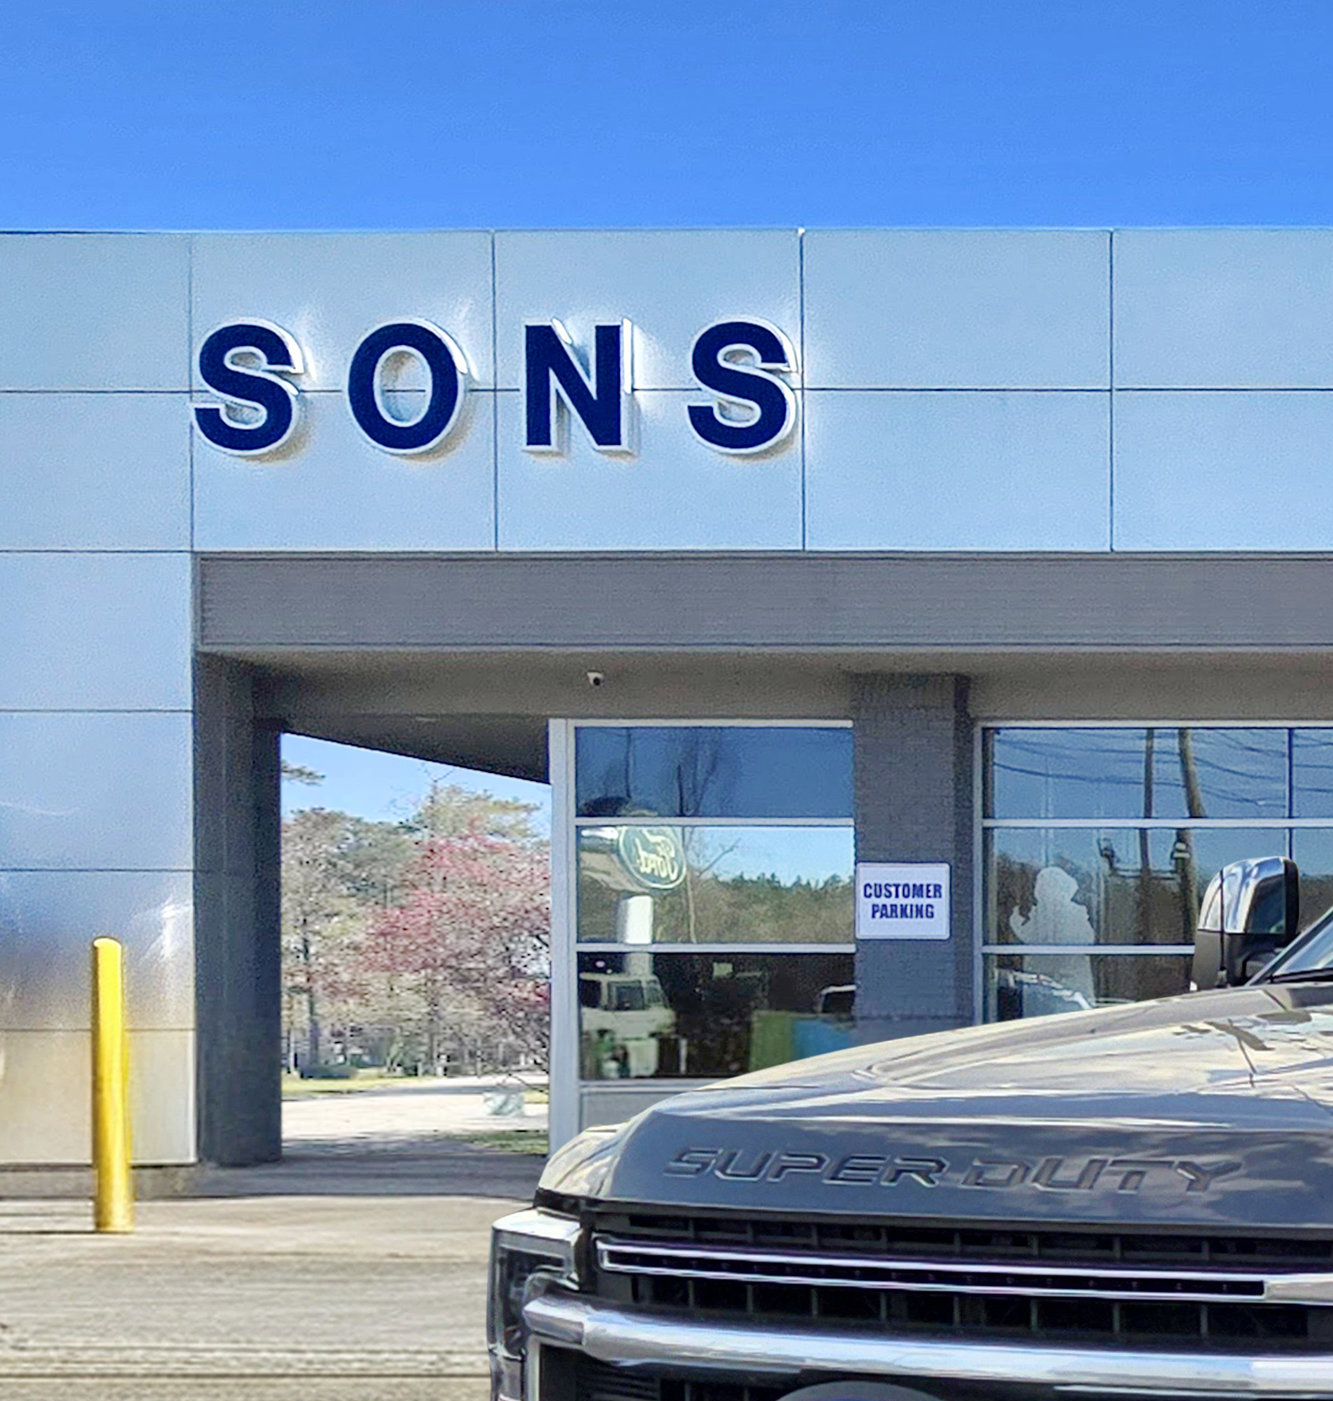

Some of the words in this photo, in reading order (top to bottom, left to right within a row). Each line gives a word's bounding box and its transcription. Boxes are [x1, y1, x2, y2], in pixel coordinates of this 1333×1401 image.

[194, 319, 797, 455] SONS
[863, 882, 943, 899] CUSTOMER
[871, 903, 935, 919] PARKING
[664, 1146, 949, 1188] SUPER
[958, 1156, 1245, 1194] DUTY
